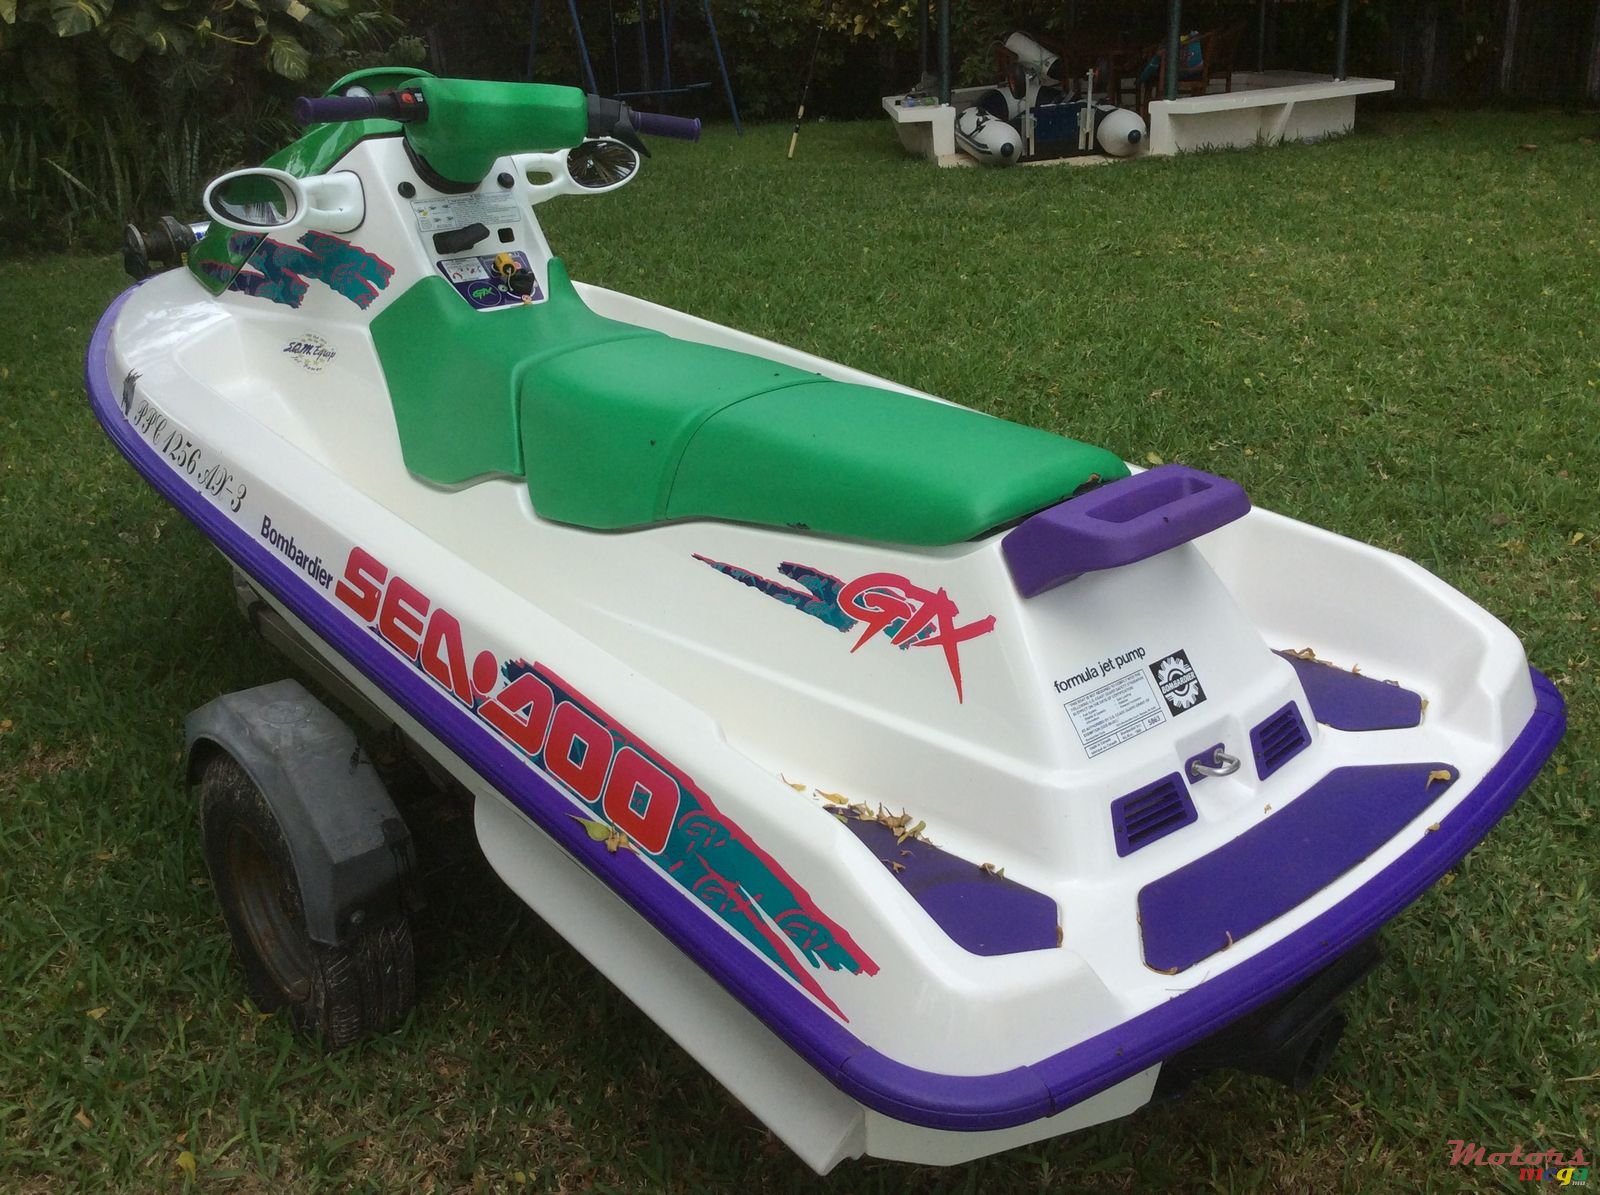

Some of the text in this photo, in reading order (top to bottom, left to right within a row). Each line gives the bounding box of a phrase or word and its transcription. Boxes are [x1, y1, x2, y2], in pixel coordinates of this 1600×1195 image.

[163, 430, 202, 475] 1256
[261, 515, 334, 590] Bombardier
[837, 572, 996, 705] GTX
[1053, 666, 1099, 694] formula
[1098, 659, 1115, 678] jet
[1115, 646, 1146, 670] pump
[1161, 671, 1196, 694] BOMBARDIER
